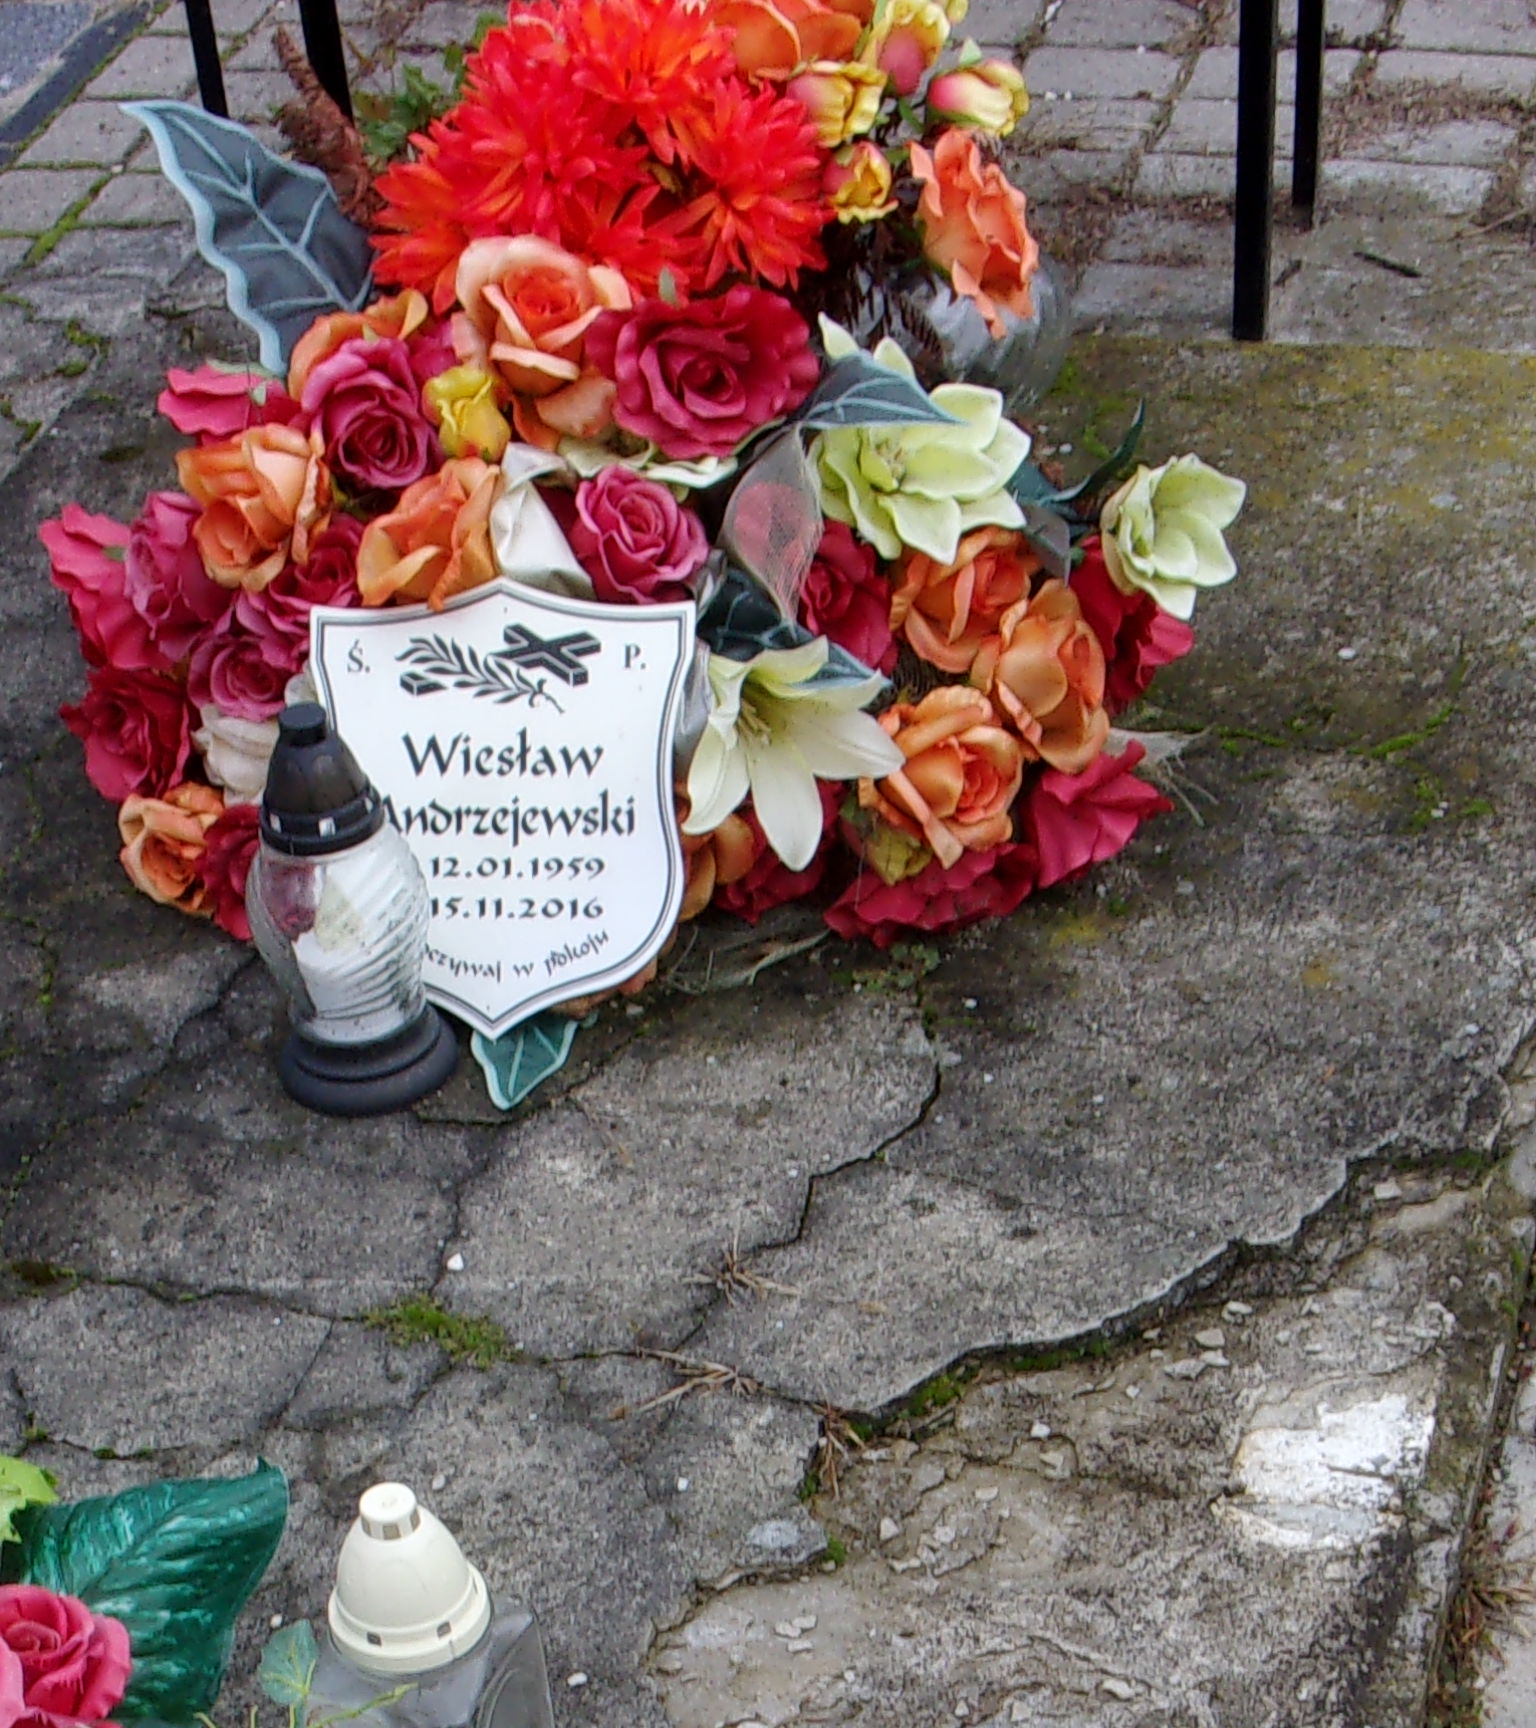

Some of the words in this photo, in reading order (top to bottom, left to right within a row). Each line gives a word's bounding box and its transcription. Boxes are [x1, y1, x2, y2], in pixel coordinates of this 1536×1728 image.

[346, 639, 371, 674] Ś.
[624, 644, 647, 671] P.
[401, 726, 605, 778] Wiesław
[381, 788, 636, 848] Andrzejewski
[429, 856, 606, 881] 12.01.1959
[429, 895, 605, 920] 15.11.2016
[511, 961, 535, 978] w
[543, 928, 610, 977] pokoju
